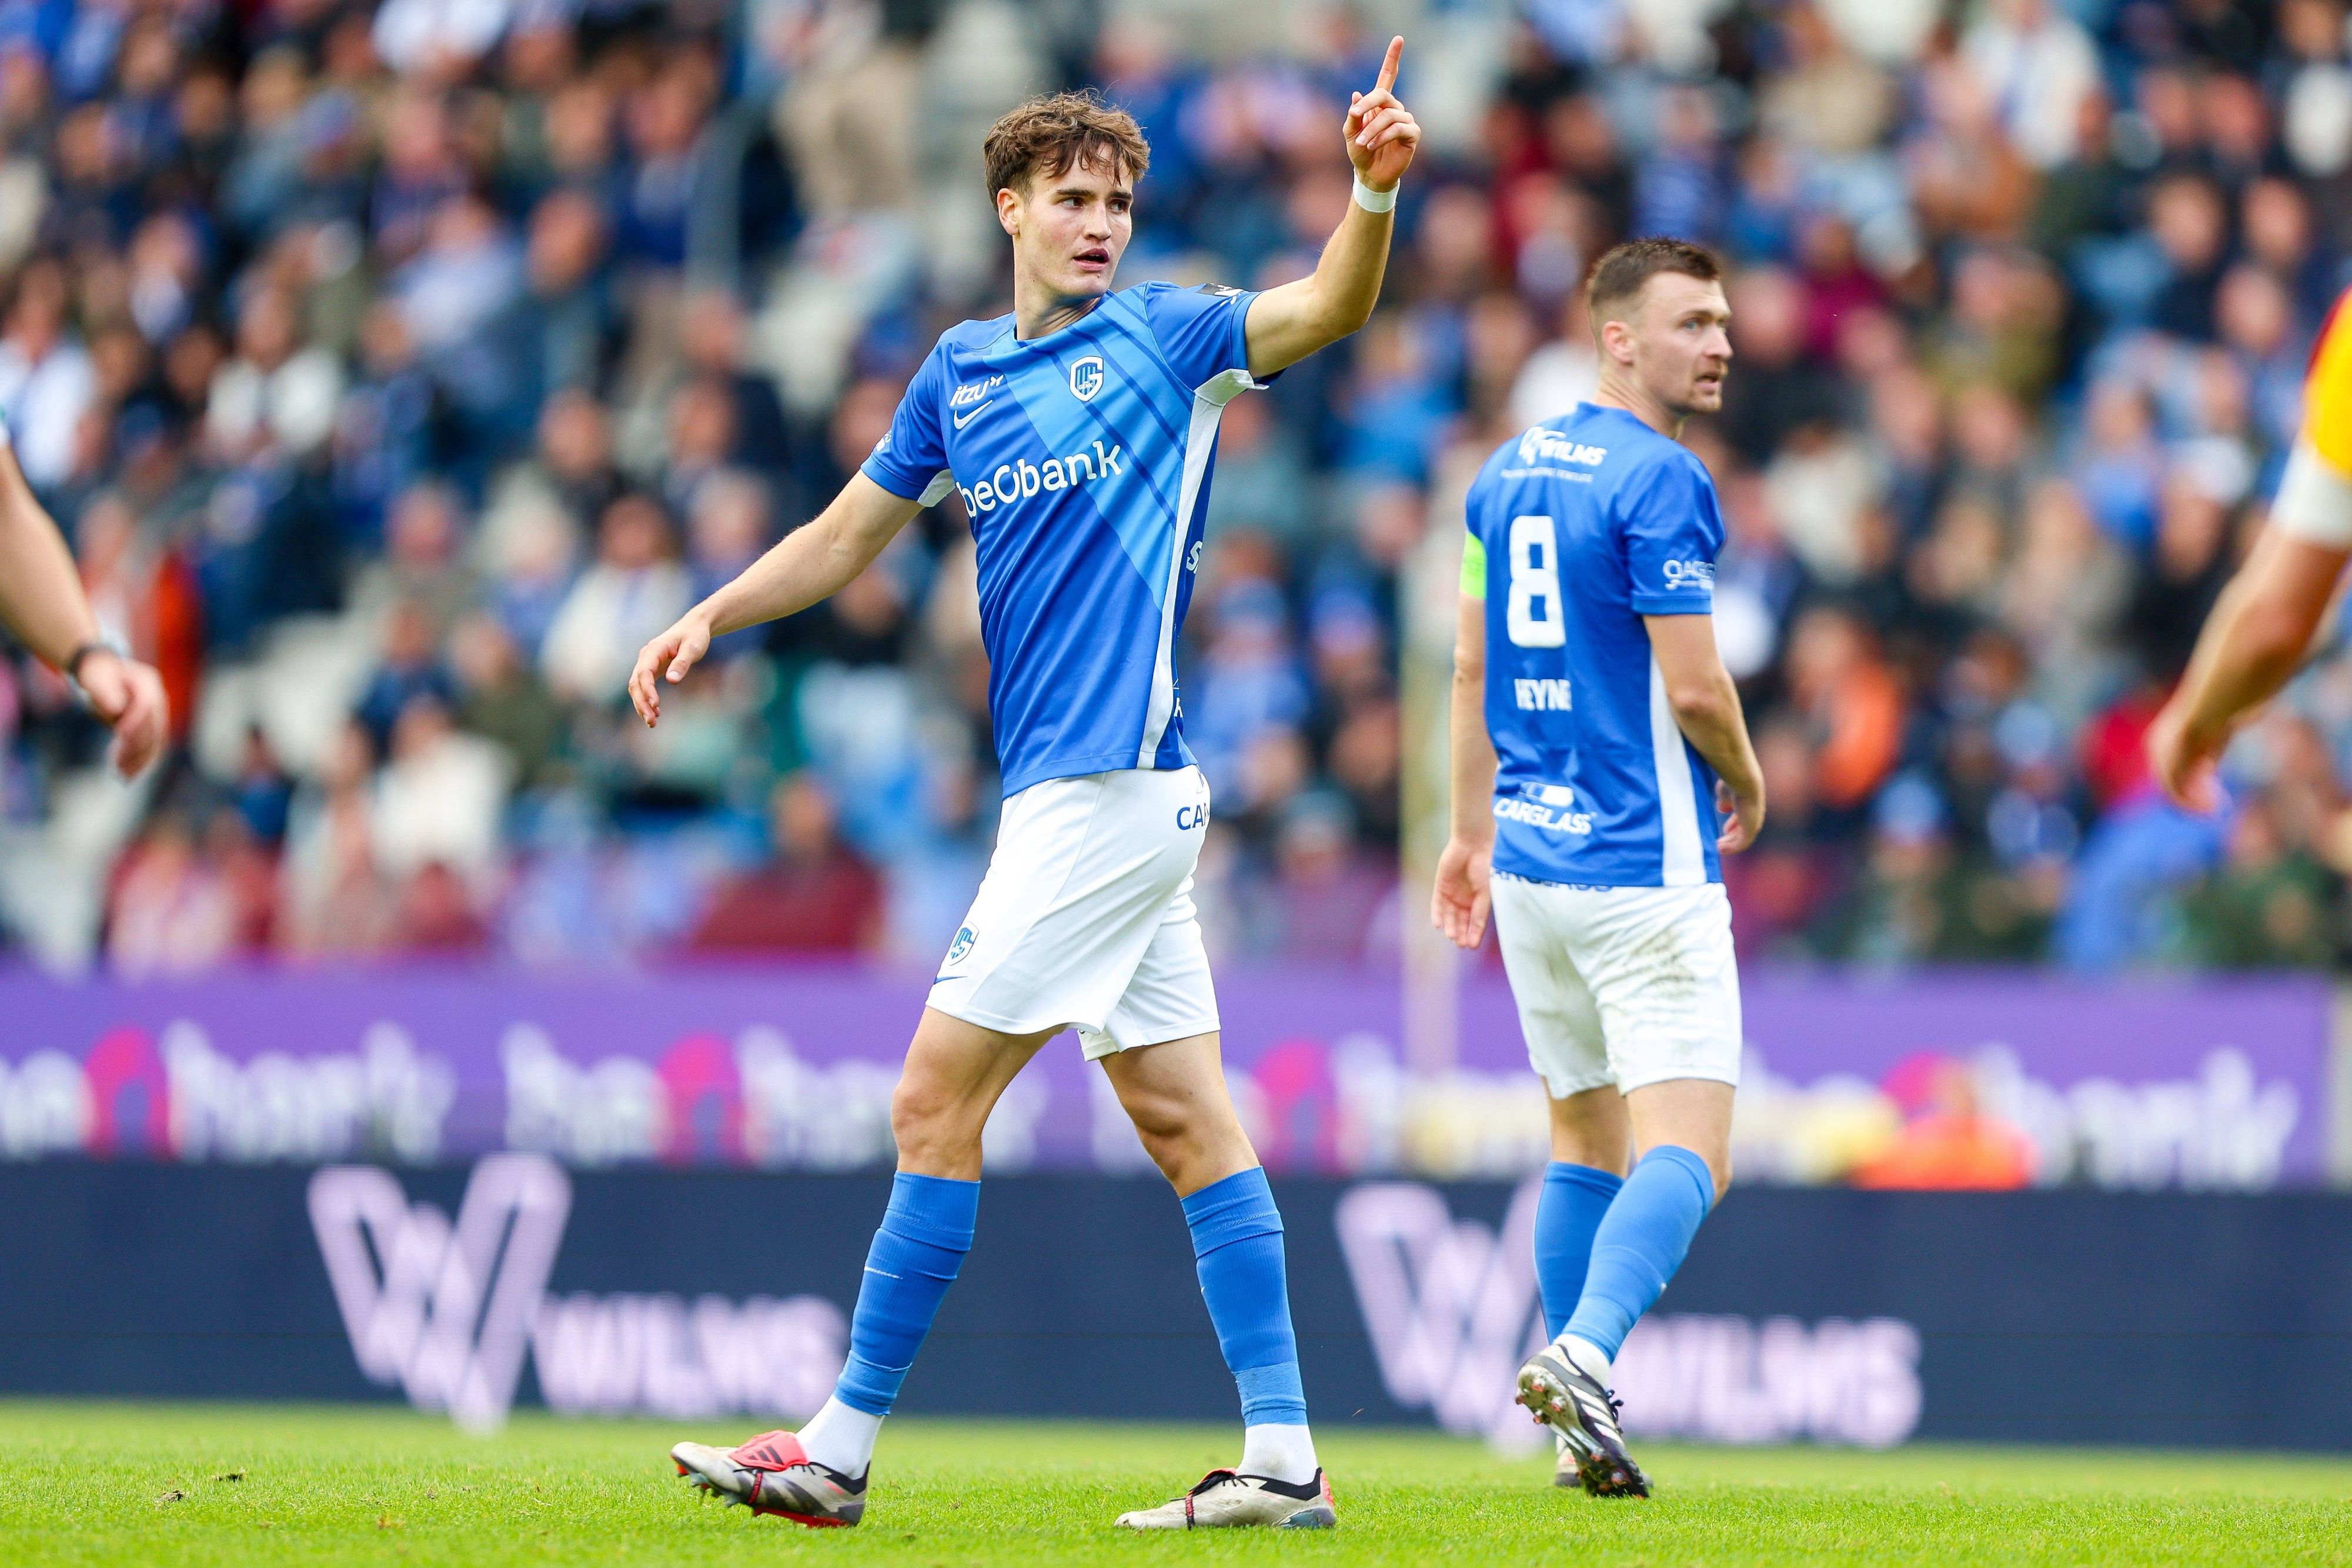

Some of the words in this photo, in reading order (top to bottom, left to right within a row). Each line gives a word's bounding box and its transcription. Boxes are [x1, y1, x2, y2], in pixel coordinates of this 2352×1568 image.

[949, 379, 990, 407] itzu
[1506, 514, 1566, 649] 8
[1492, 797, 1593, 836] CARGLASS
